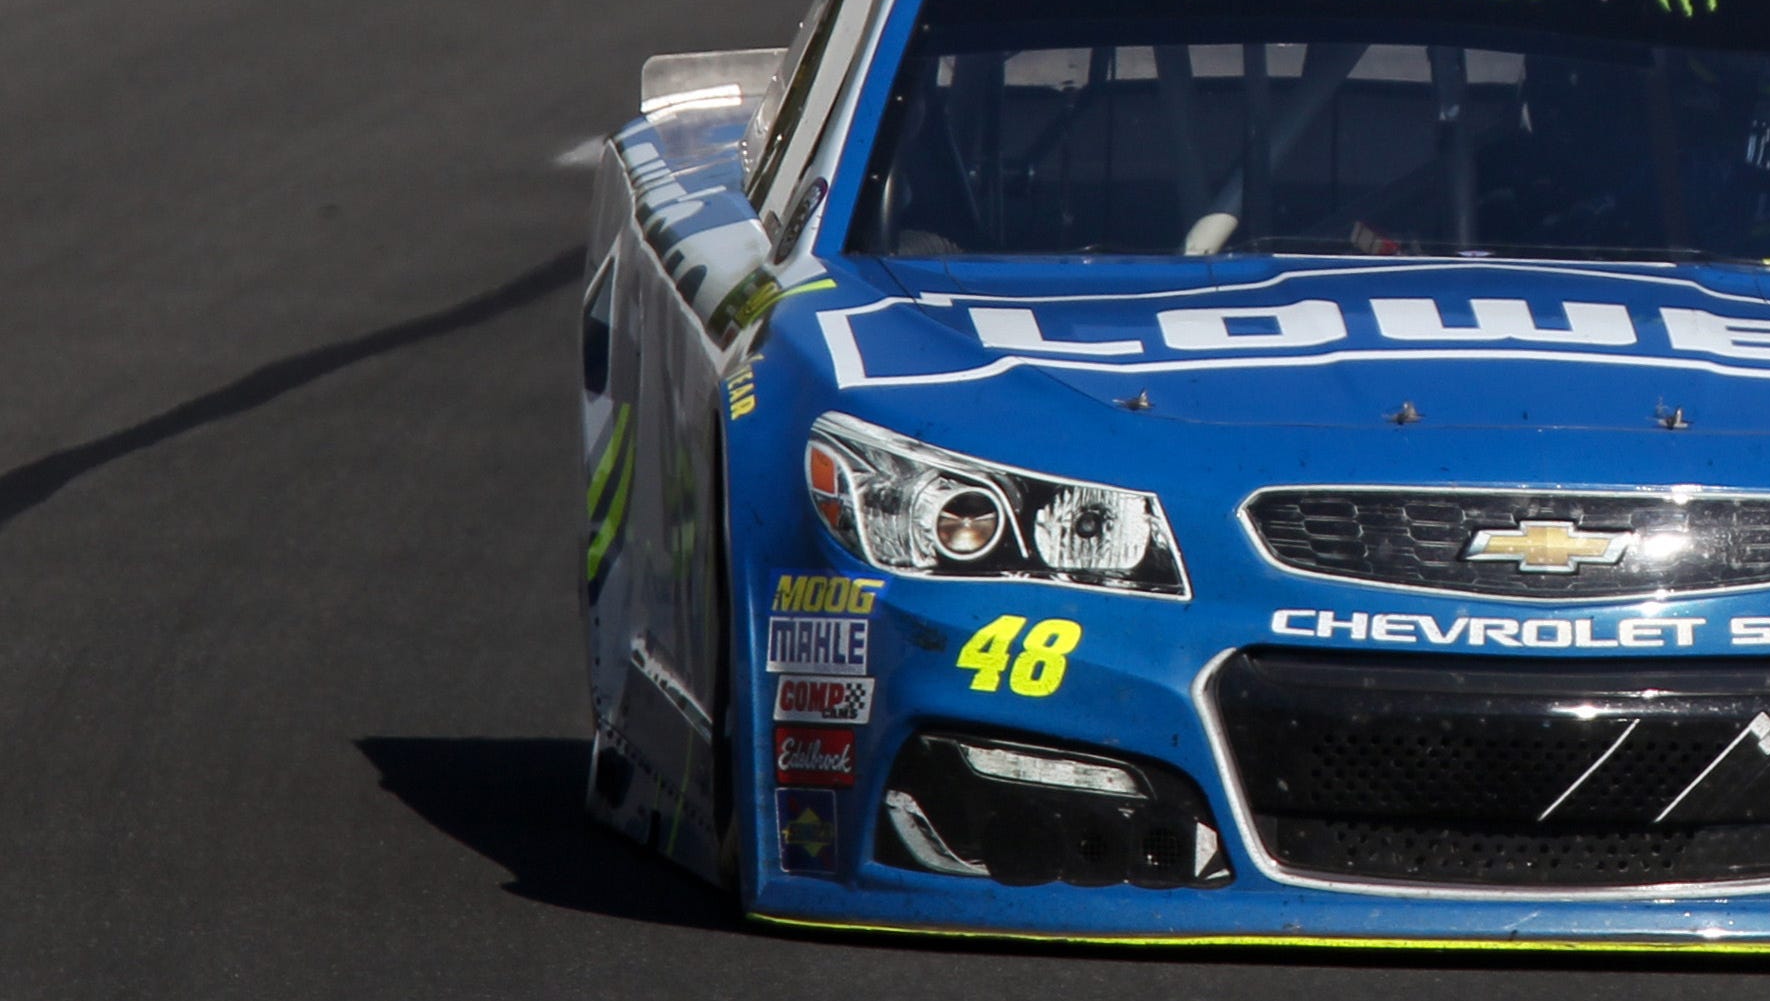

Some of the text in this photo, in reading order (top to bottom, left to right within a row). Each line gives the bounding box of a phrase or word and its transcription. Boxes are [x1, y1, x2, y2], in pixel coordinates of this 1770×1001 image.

[772, 575, 885, 614] MOOG
[769, 620, 866, 665] MAHLE
[1271, 609, 1706, 648] CHEVROLET
[956, 615, 1083, 697] 48
[779, 680, 845, 713] COMP
[778, 737, 852, 773] Edelbrock
